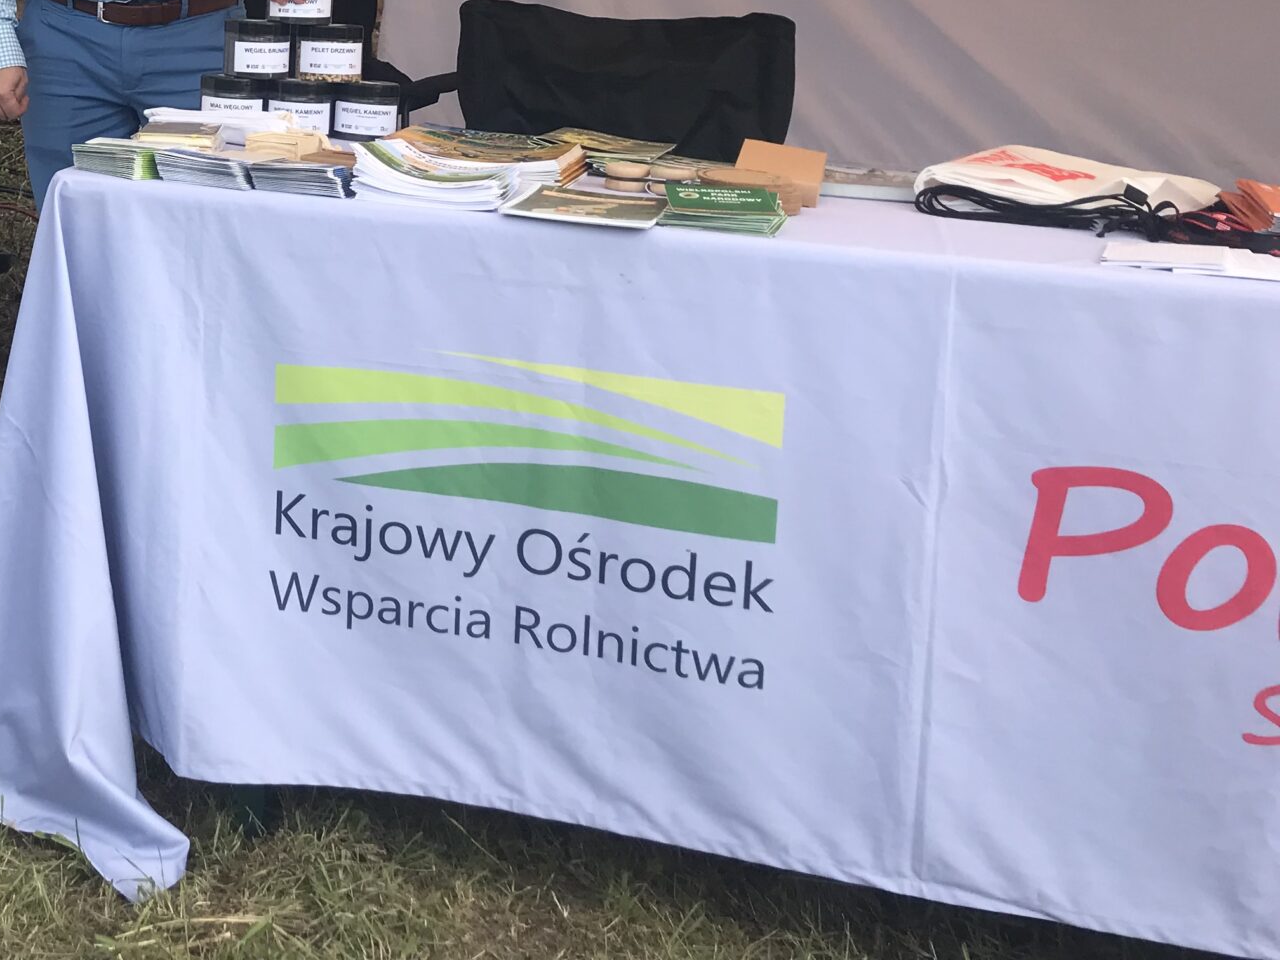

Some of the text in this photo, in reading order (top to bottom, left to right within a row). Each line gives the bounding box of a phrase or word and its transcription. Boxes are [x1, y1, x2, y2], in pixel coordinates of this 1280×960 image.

[274, 489, 775, 614] Krajowy Ośrodek
[269, 570, 766, 690] Wsparcia Rolnictwa
